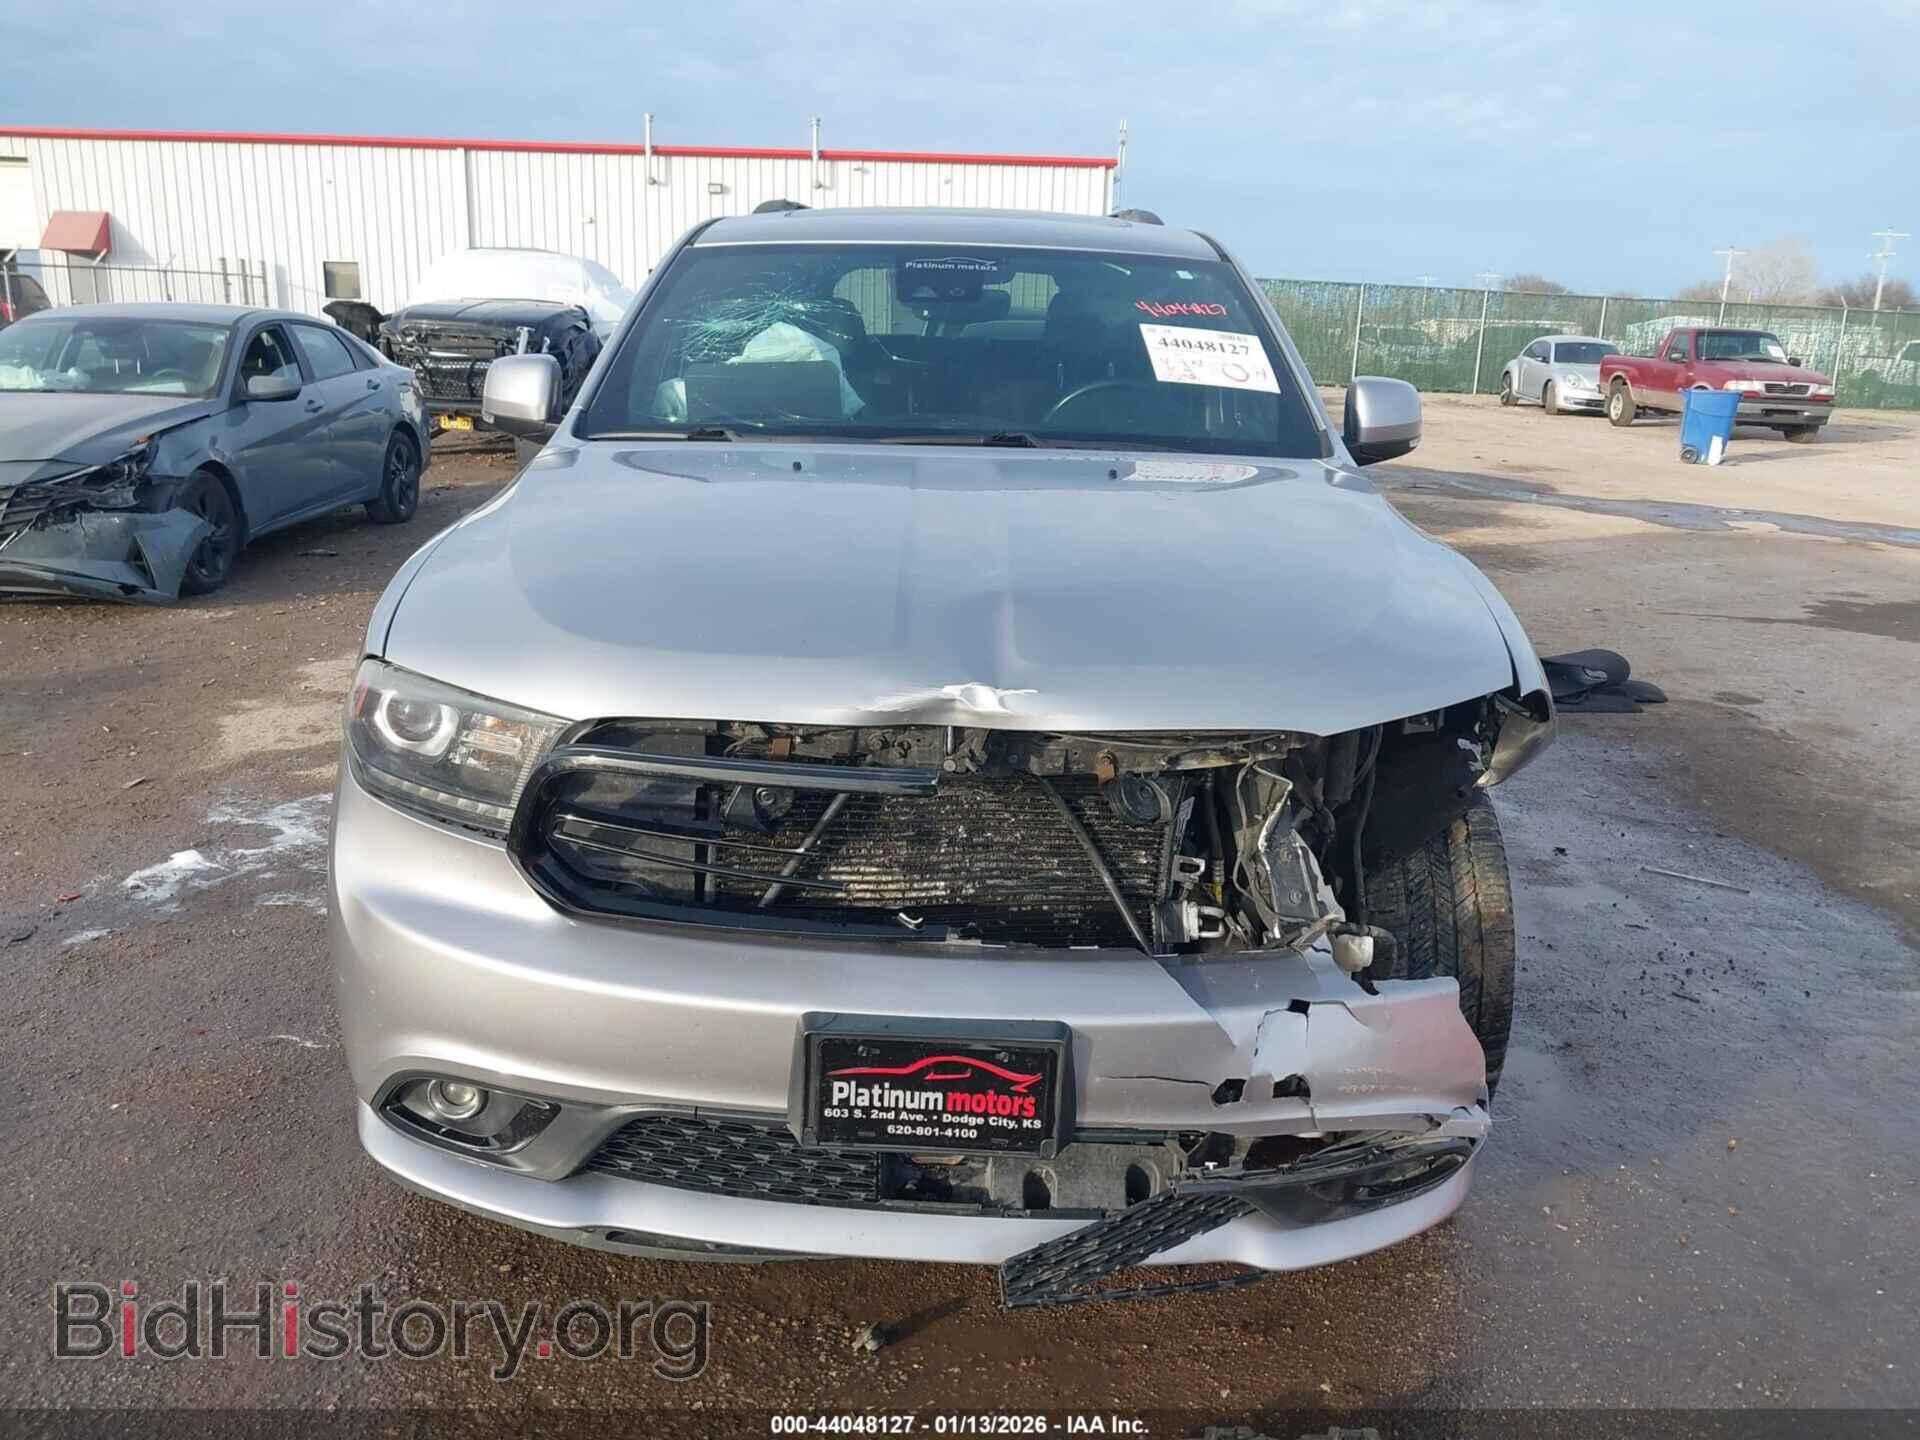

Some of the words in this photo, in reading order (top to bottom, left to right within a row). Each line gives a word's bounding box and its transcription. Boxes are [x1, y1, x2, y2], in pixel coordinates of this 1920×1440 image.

[905, 261, 955, 270] Platinum
[957, 262, 998, 271] motors
[1158, 336, 1249, 355] 44048127
[832, 1080, 943, 1111] Platinum
[946, 1088, 1036, 1117] motors
[824, 1107, 849, 1119] 603
[853, 1109, 866, 1119] S.
[870, 1109, 895, 1120] 2nd
[900, 1112, 928, 1122] Ave.
[942, 1113, 984, 1126] Dodge
[988, 1115, 1019, 1129] City,
[1022, 1118, 1042, 1129] KS
[887, 1124, 978, 1139] 620-801-4100
